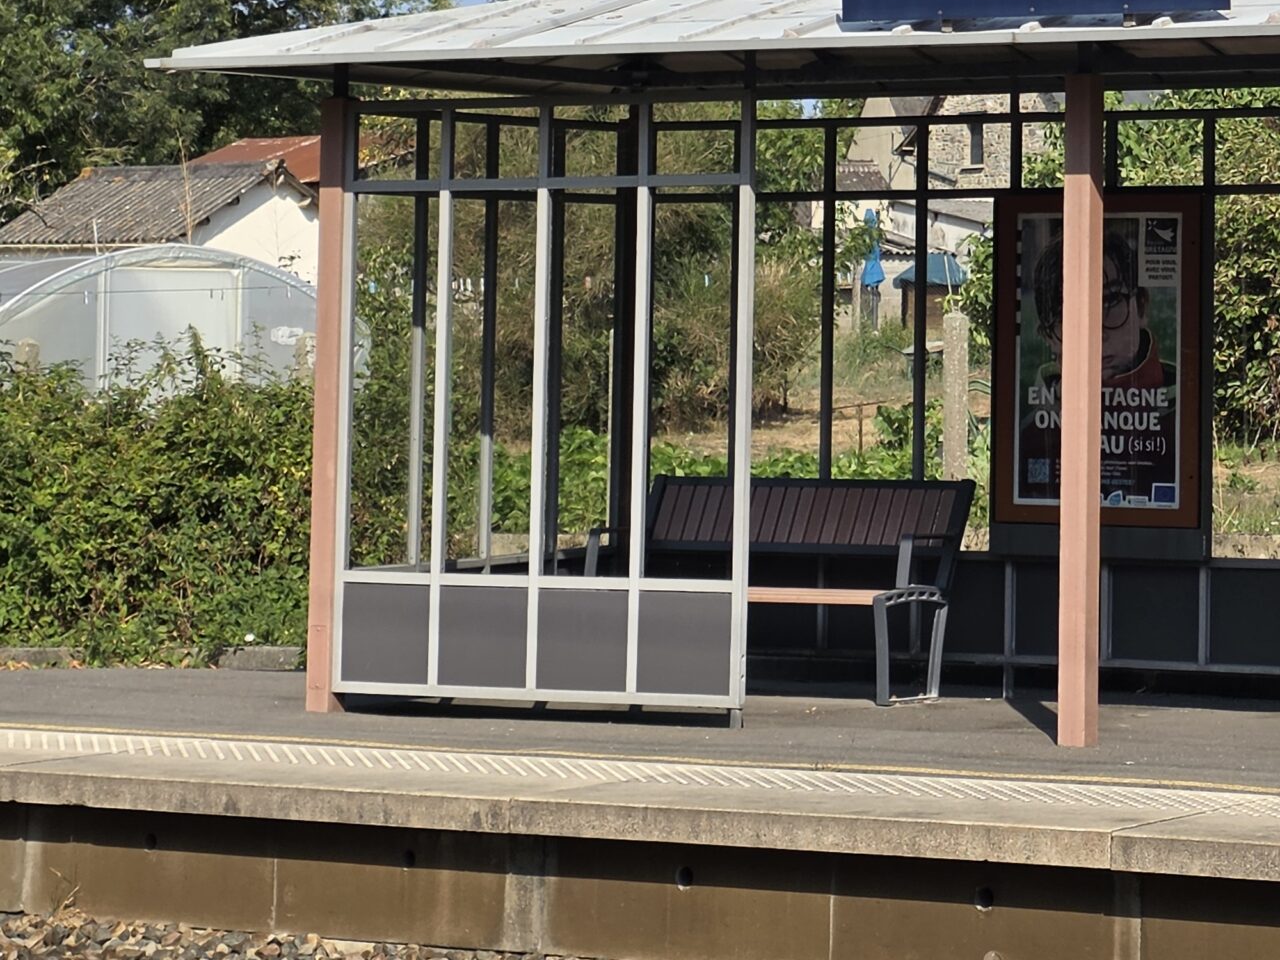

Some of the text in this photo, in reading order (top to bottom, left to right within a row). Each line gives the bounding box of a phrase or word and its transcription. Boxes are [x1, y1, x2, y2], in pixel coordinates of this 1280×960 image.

[1027, 386, 1169, 407] EN TAGNE
[1034, 410, 1161, 431] ON NQUE
